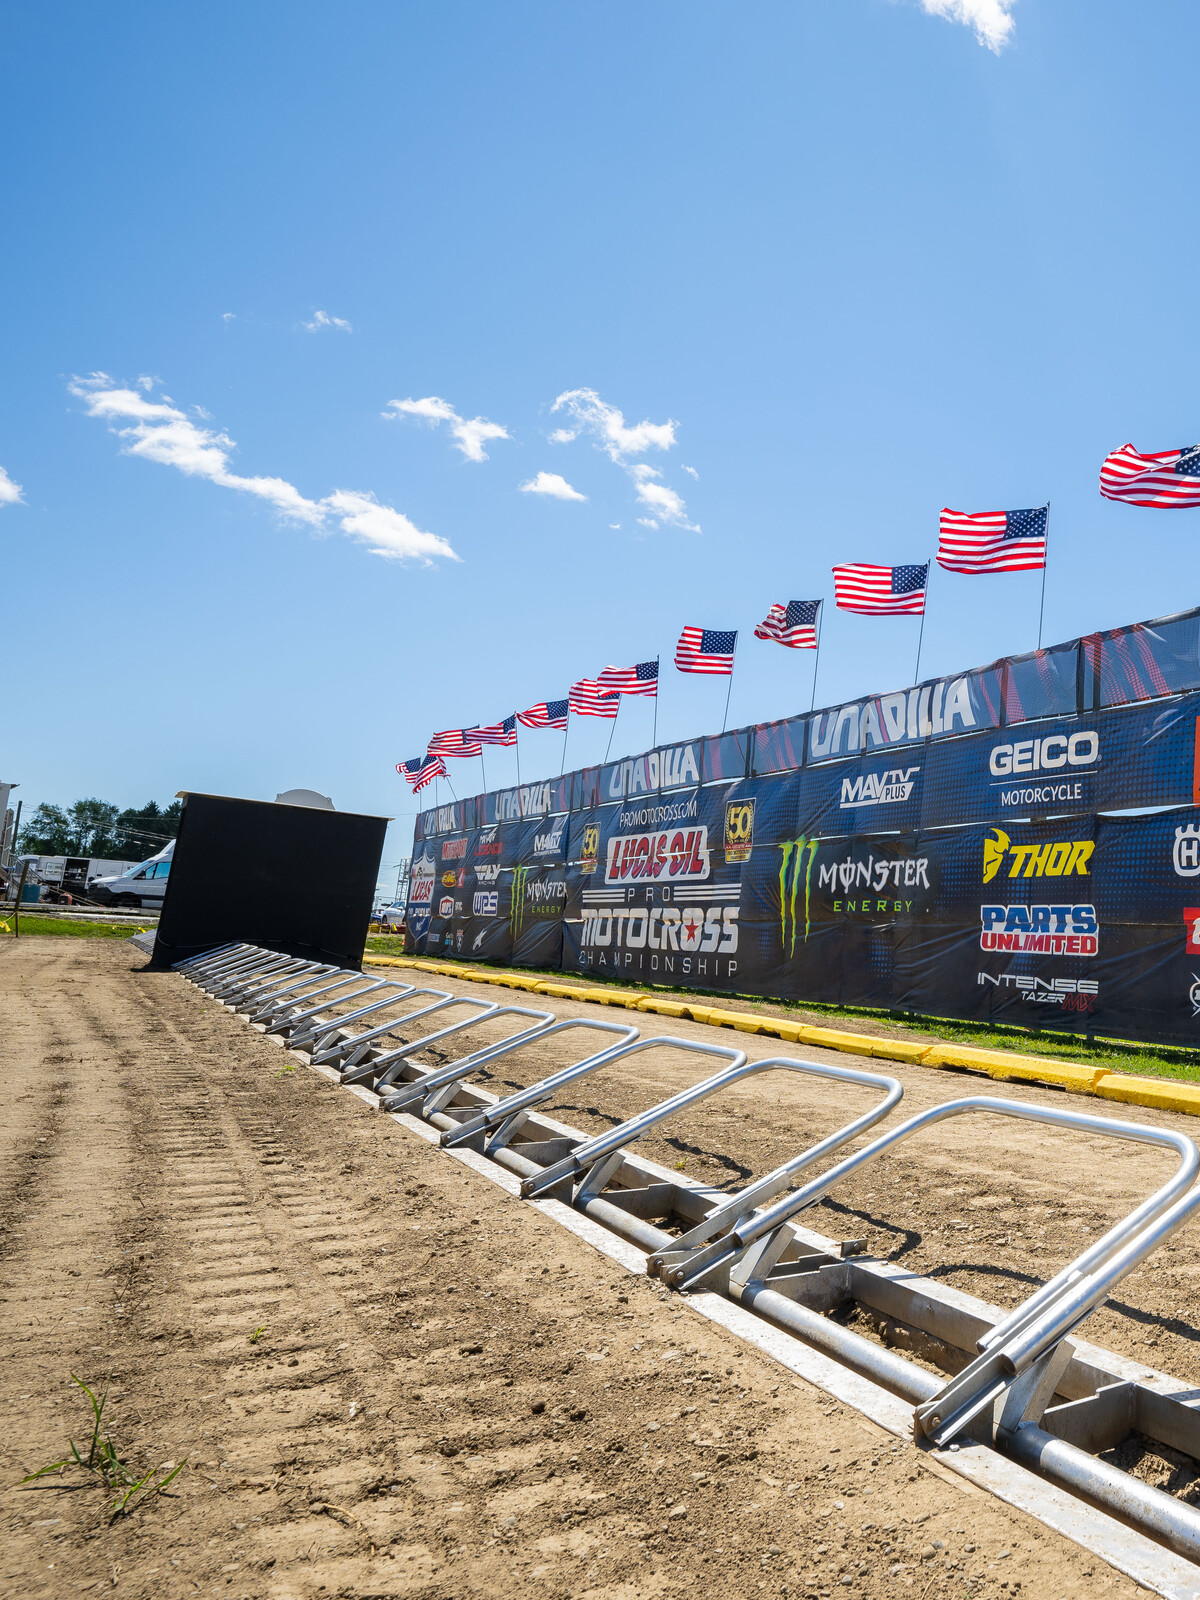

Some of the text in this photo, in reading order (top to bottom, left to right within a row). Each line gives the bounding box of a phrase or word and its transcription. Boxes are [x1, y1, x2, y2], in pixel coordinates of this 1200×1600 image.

[811, 677, 976, 758] UNADILLA
[989, 731, 1099, 776] GEICO
[609, 744, 700, 798] UNADILLA
[885, 785, 906, 800] PLUS
[1001, 783, 1082, 807] MOTORCYCLE
[729, 806, 751, 840] 50
[585, 828, 598, 855] 50
[608, 830, 704, 880] LUCAS OIL
[1008, 840, 1095, 878] THOR
[474, 892, 498, 916] WPS
[627, 886, 671, 903] PRO
[833, 900, 913, 912] ENERGY
[531, 905, 562, 914] ENERGY
[981, 904, 1098, 933] PARTS
[581, 906, 740, 954] MOTOCROSS
[980, 931, 1098, 956] UNLIMITED
[578, 951, 738, 977] CHAMPIONSHIP
[977, 972, 1099, 994] INTENSE
